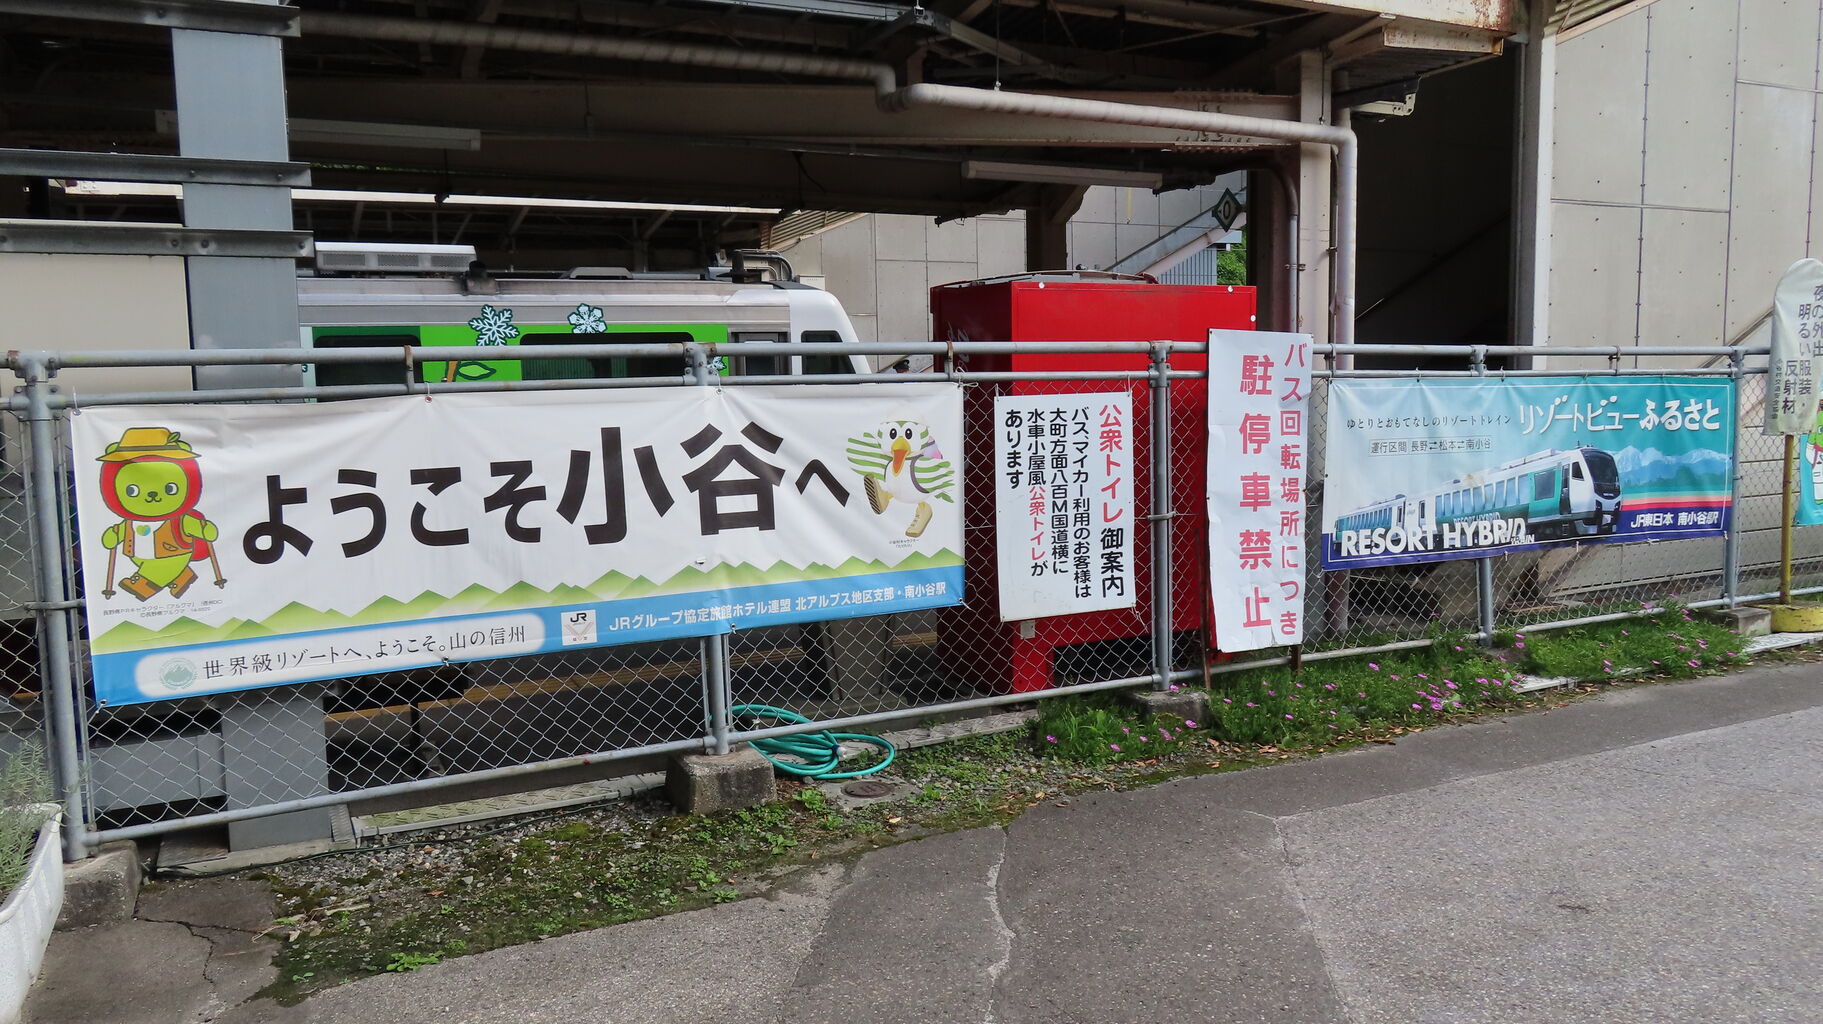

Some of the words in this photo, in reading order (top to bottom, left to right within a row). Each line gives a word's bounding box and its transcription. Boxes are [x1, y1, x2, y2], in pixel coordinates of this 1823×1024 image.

[1518, 395, 1721, 435] リゾートビューふるさと
[1782, 360, 1798, 414] 反射材
[1005, 409, 1024, 489] あります
[1279, 343, 1307, 635] バス回転場所につき
[242, 421, 851, 564] ようこそ小谷へ
[1027, 408, 1048, 576] 水車小屋風公衆トイレが
[1049, 407, 1069, 575] 大町方面八百M国道横に
[1071, 407, 1092, 598] バス、マイカー利用のお客様は
[1099, 404, 1124, 598] 公衆トイレ御案内
[1238, 355, 1274, 628] 駐停車禁止
[1631, 512, 1674, 528] JR東日本
[1677, 511, 1719, 526] 南小谷駅
[1341, 526, 1434, 557] RESORT
[1443, 517, 1526, 549] HYBRID
[570, 612, 587, 623] JR
[609, 600, 792, 631] JRグループ協定旅館ホテル連盟
[796, 581, 946, 610] 北アルプス地区支部・南小谷駅
[203, 625, 525, 679] 世界級リゾートへ、ようこそ。山の信州
